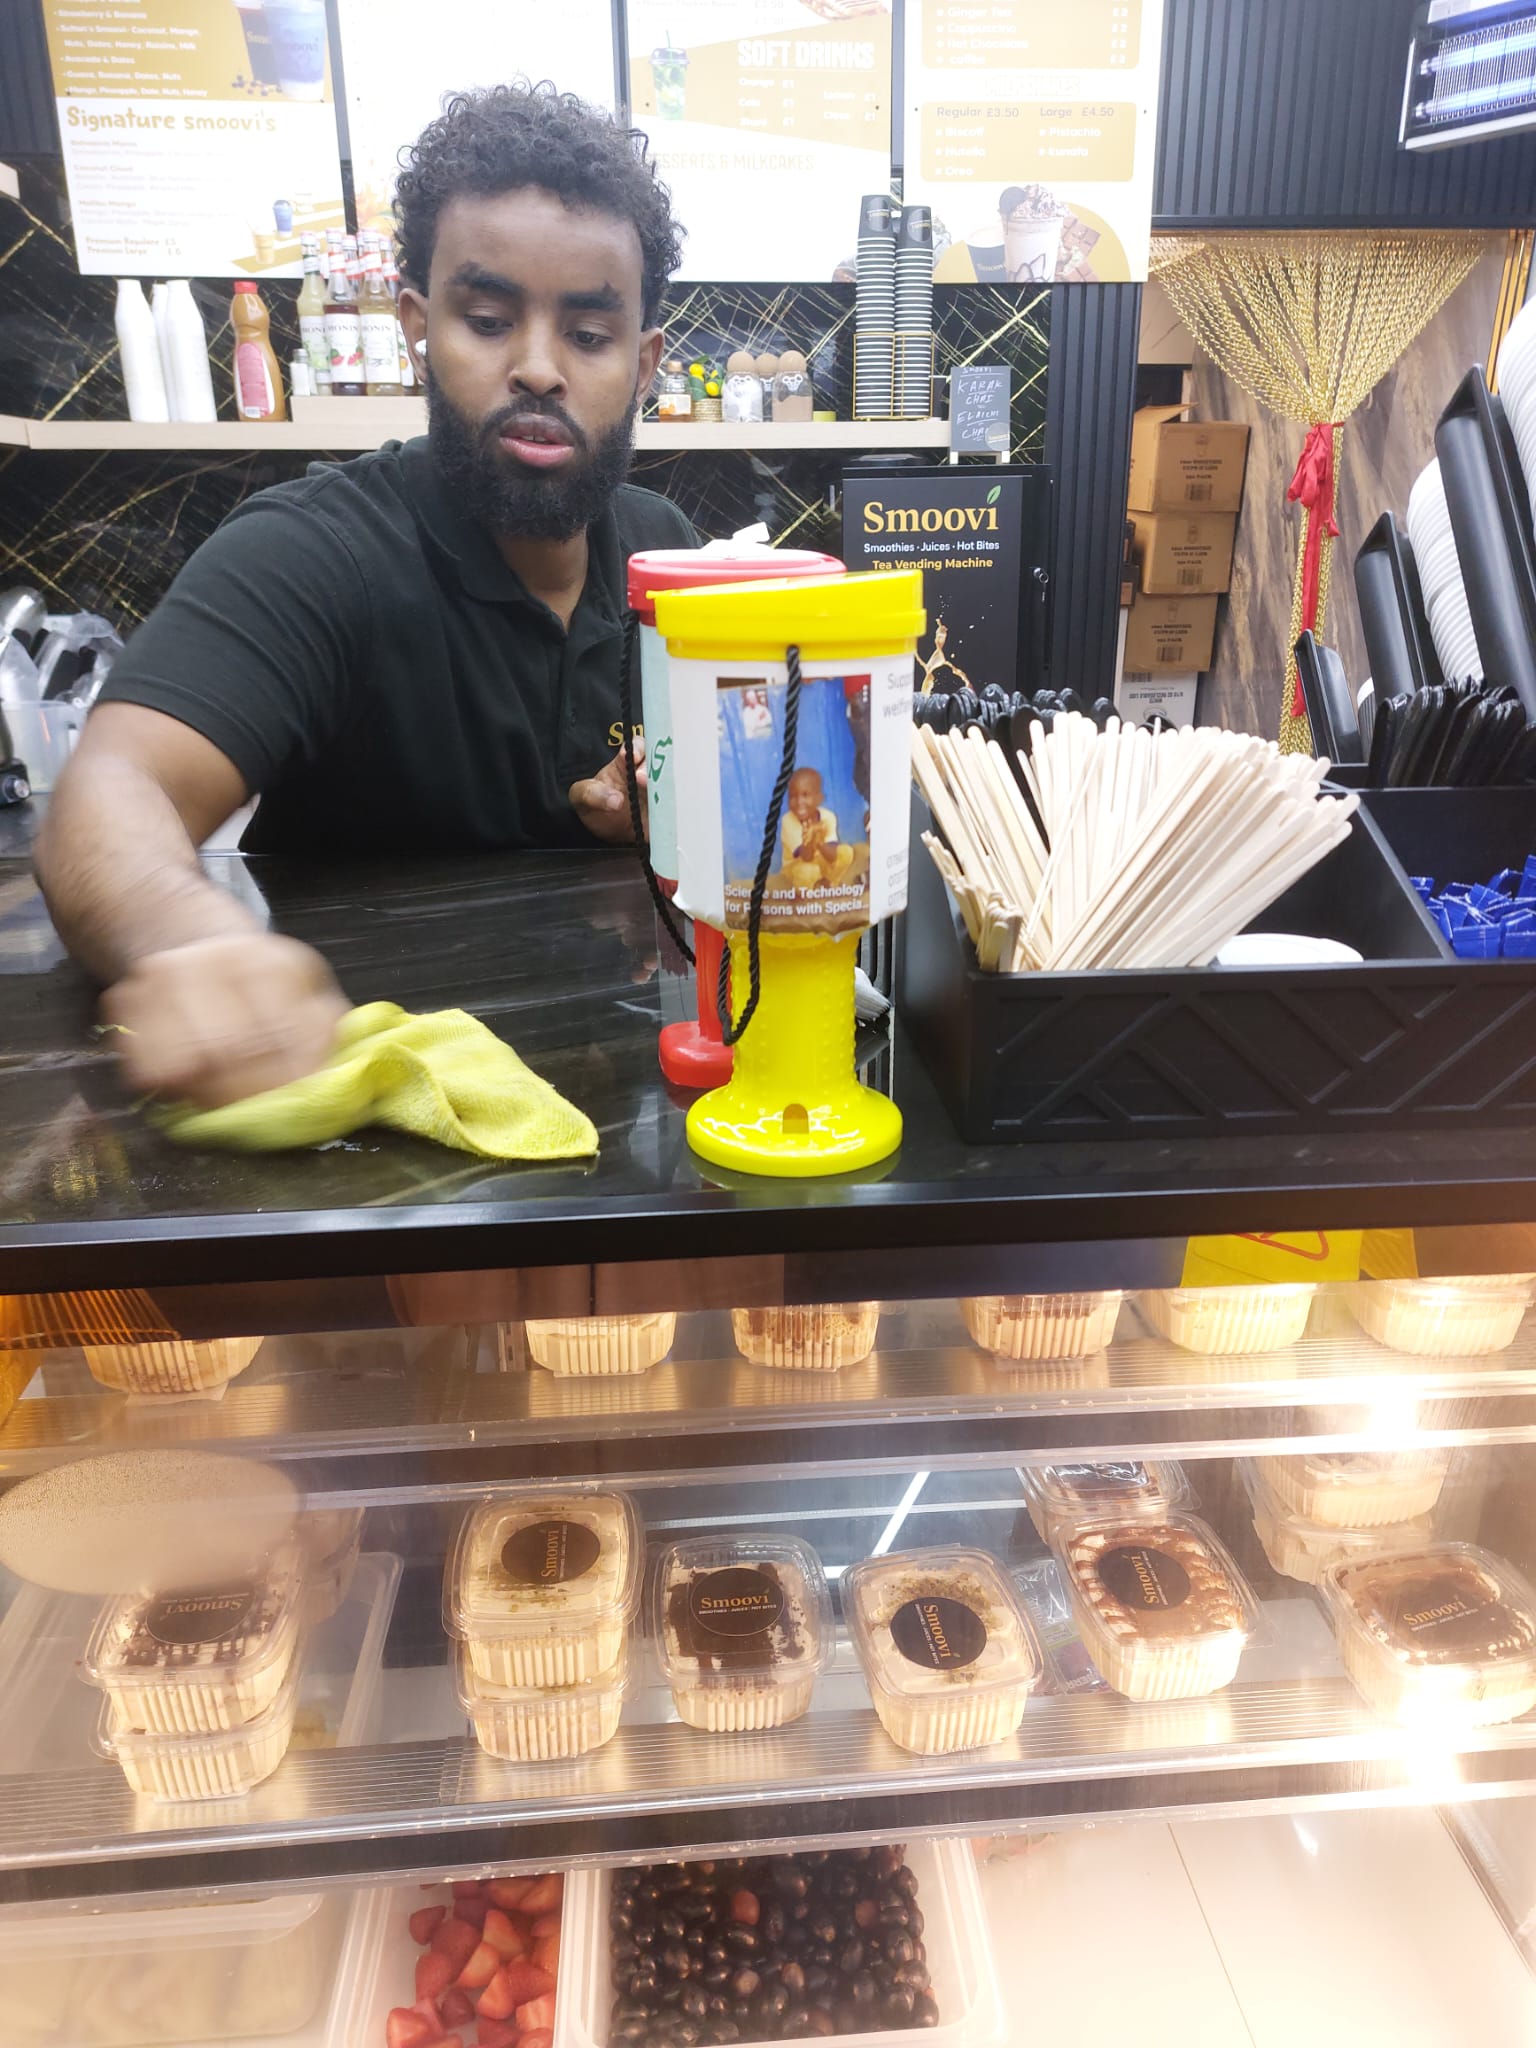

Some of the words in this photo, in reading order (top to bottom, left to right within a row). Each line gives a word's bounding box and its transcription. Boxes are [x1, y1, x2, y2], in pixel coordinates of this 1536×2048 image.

[947, 7, 989, 19] Ginger
[737, 40, 791, 68] SOFT
[795, 40, 875, 69] DRINKS
[66, 105, 176, 132] Signature
[183, 109, 278, 132] smoovi's
[936, 107, 981, 119] Regular
[986, 107, 1019, 118] £3.50
[1039, 107, 1072, 119] Large
[1080, 107, 1115, 118] £4.50
[1048, 126, 1102, 138] Pistachio
[732, 152, 815, 172] MILKCAKES
[944, 165, 976, 178] Oreo
[958, 379, 1003, 393] KARAK
[863, 500, 1000, 534] Smoovi
[863, 541, 915, 553] Smoothies
[920, 541, 951, 552] Juices
[956, 541, 975, 552] Hot
[976, 540, 1000, 551] Bites
[872, 560, 893, 570] Tea
[895, 558, 942, 572] Vending
[945, 556, 993, 568] Machine
[725, 885, 768, 899] Sciene
[772, 887, 796, 899] and
[799, 882, 865, 899] Technology
[726, 900, 741, 912] for
[795, 902, 822, 915] with
[540, 1529, 560, 1578] Smoovi
[1131, 1555, 1160, 1604] Smoovi
[701, 1594, 769, 1609] Smoovi
[1403, 1600, 1467, 1626] Smoovi
[923, 1604, 951, 1659] Smoovi
